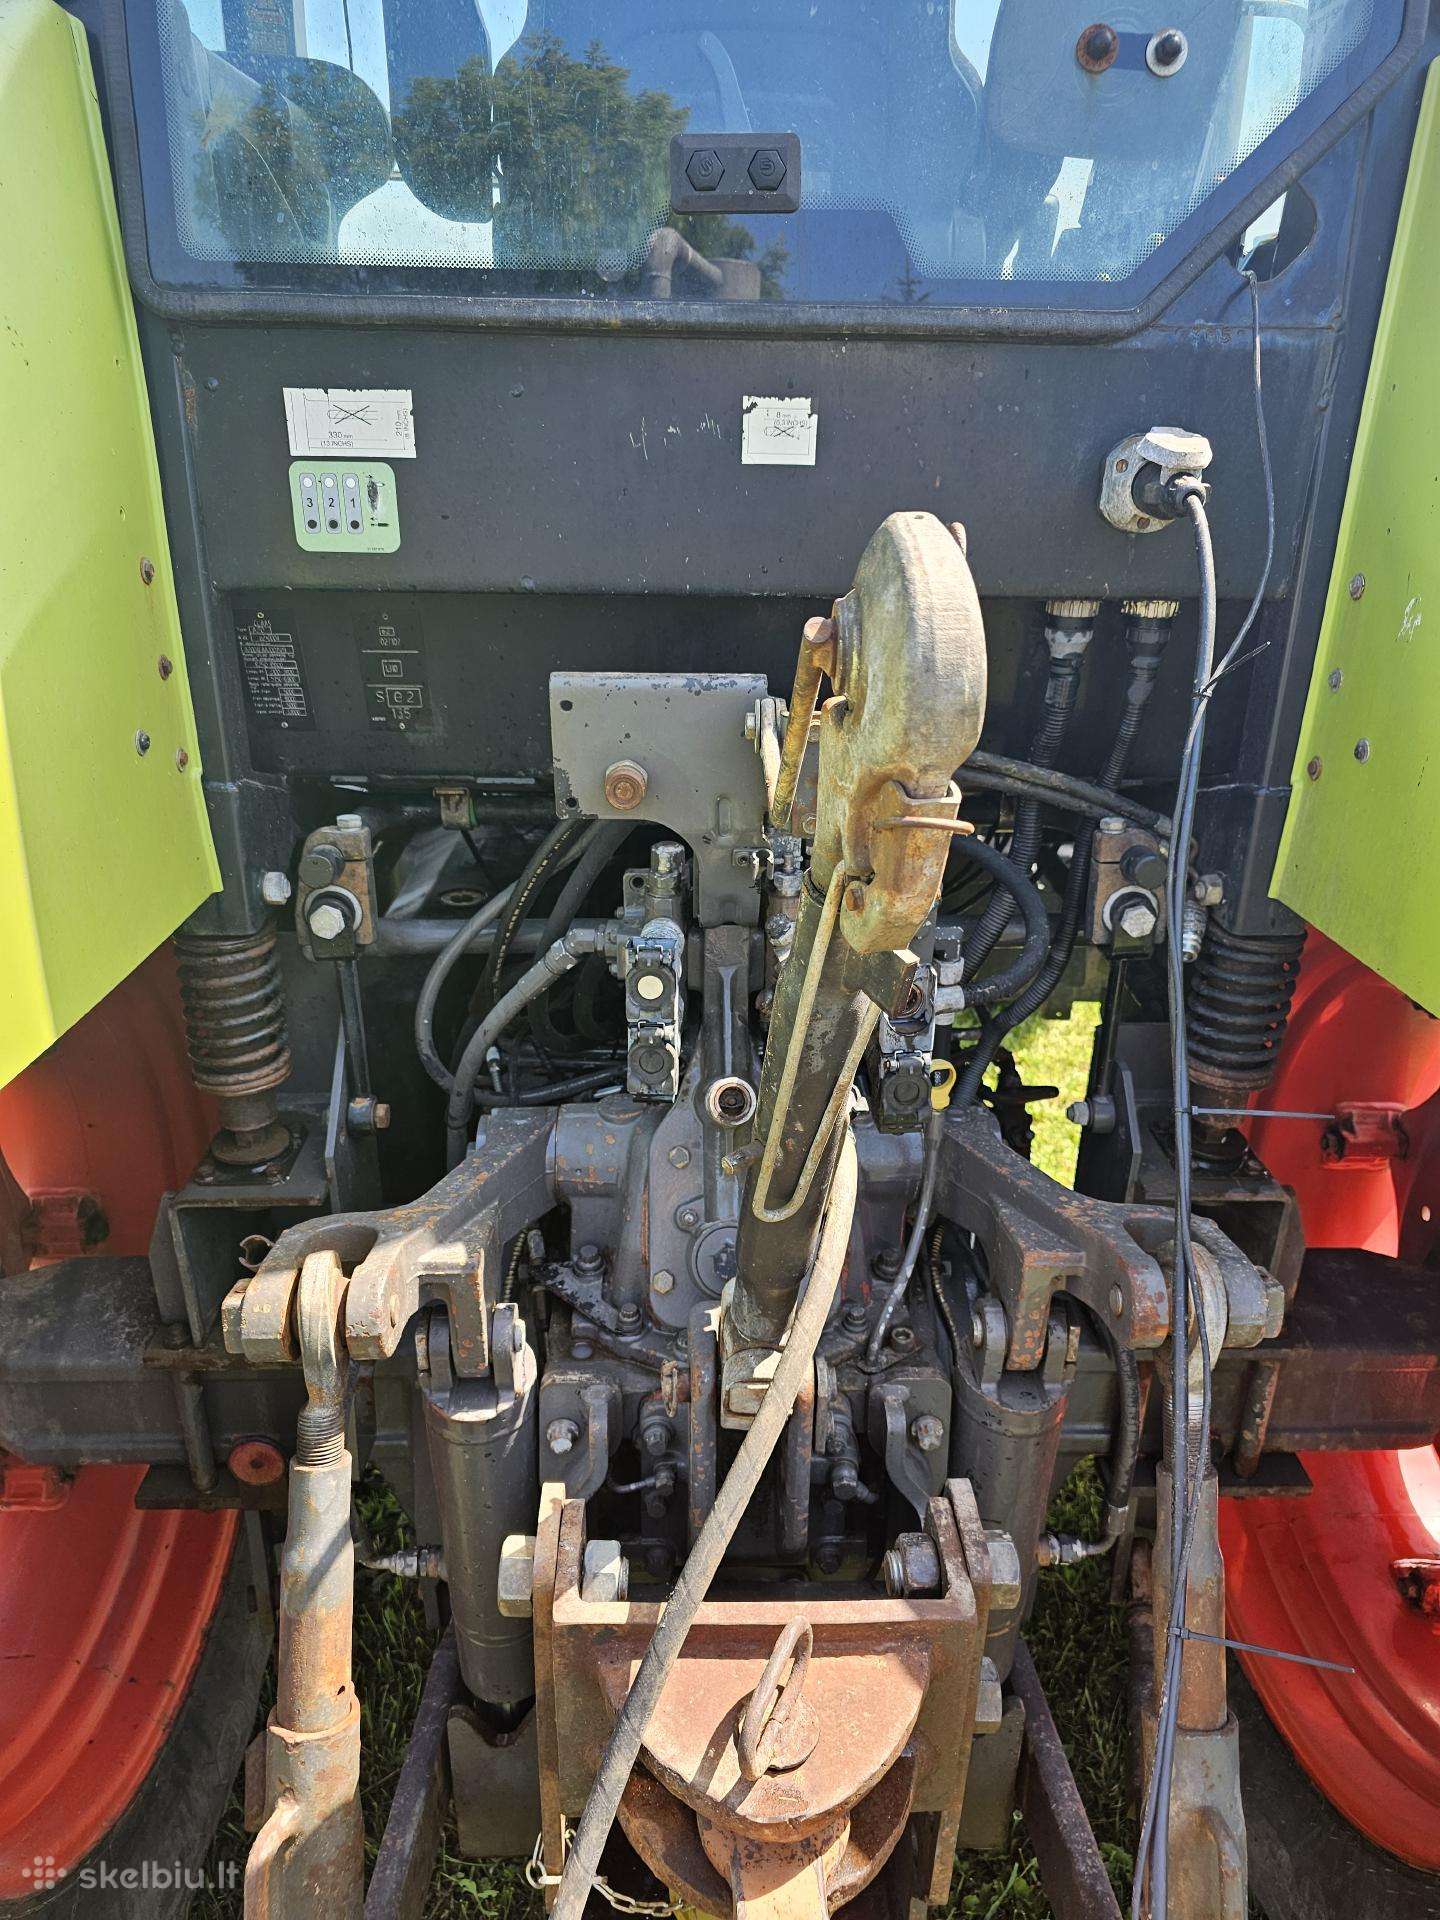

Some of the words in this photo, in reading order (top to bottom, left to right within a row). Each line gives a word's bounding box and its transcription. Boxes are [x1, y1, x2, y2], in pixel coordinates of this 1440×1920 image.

[307, 497, 314, 508] 3
[328, 497, 335, 508] 2
[350, 497, 356, 509] 1
[375, 690, 385, 703] S
